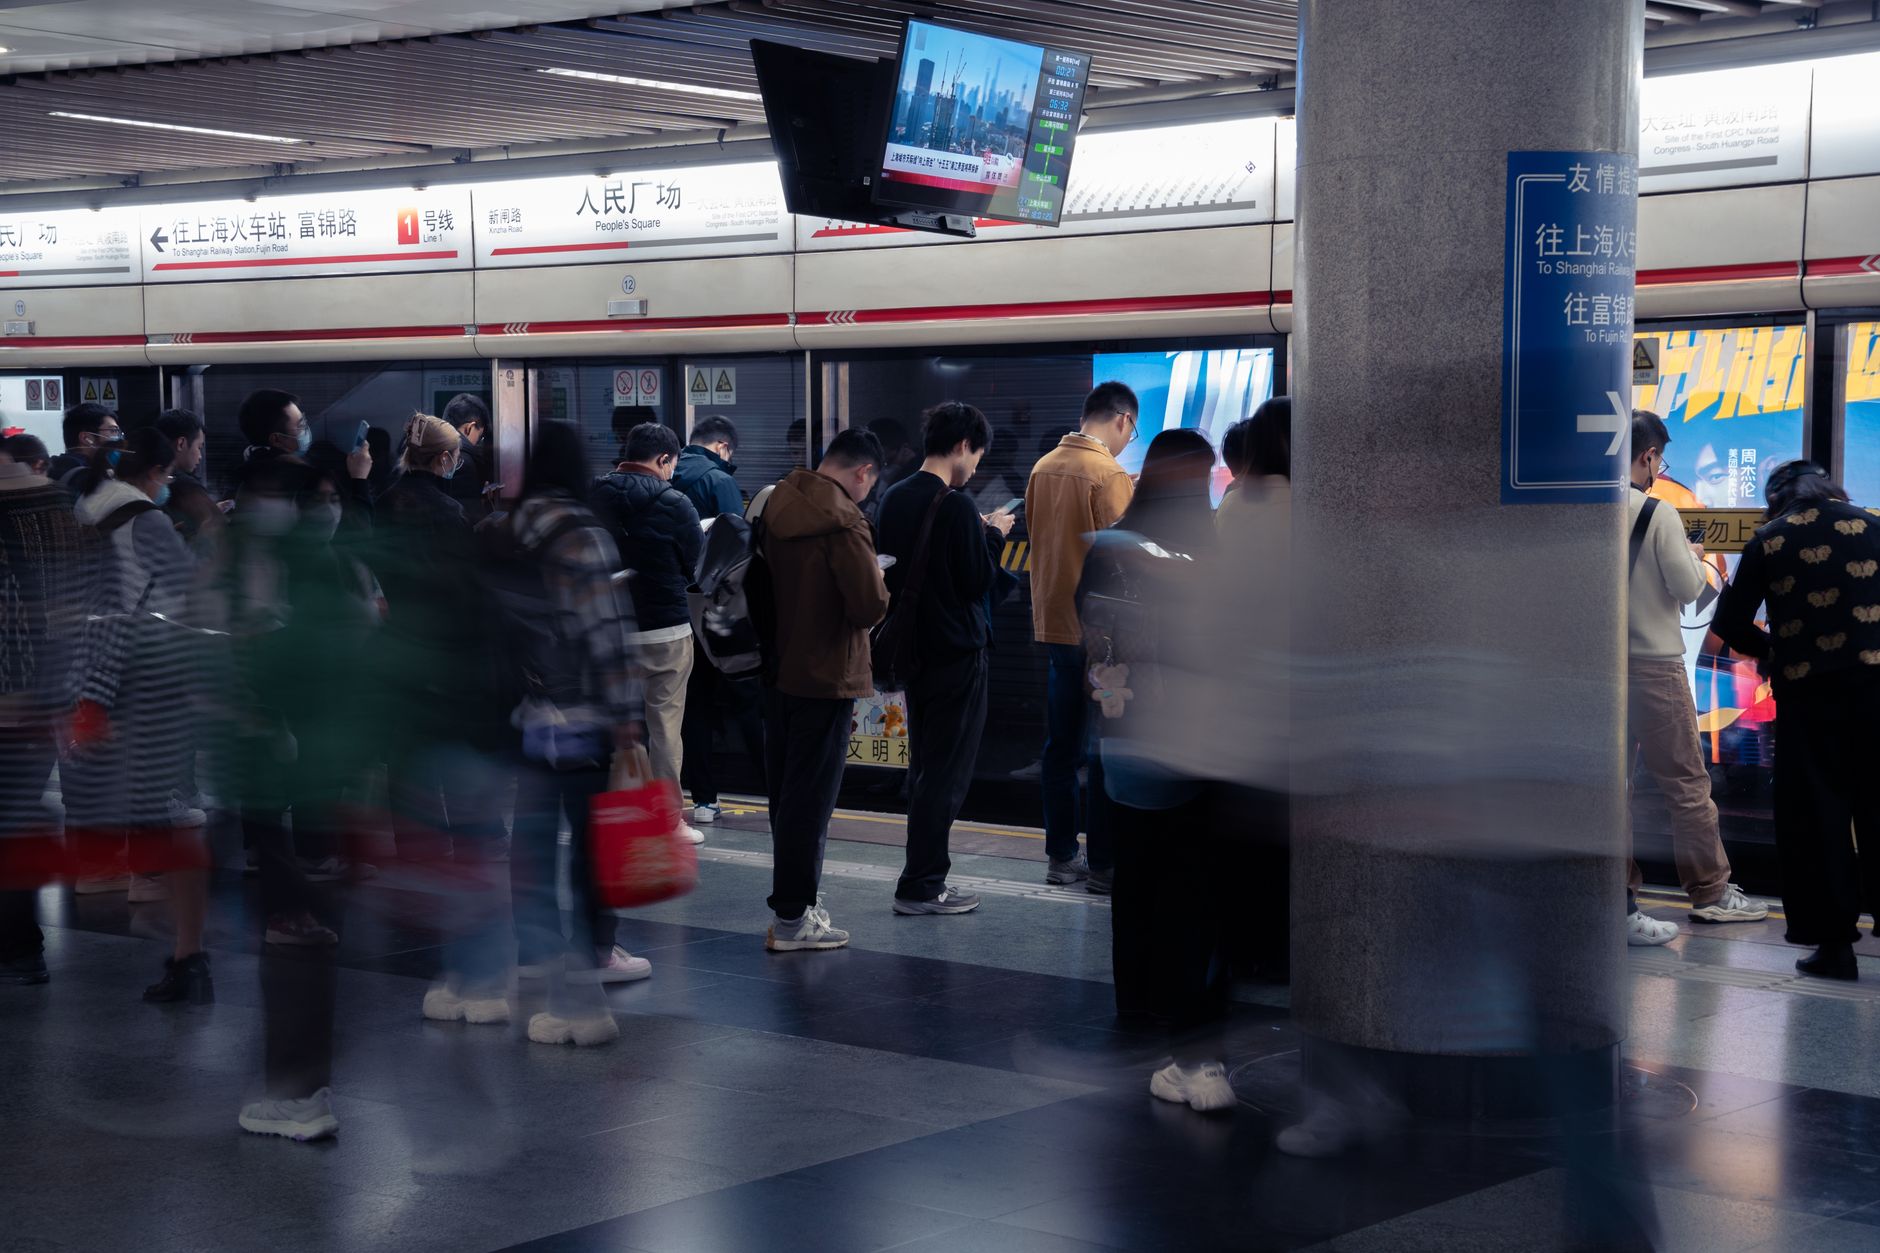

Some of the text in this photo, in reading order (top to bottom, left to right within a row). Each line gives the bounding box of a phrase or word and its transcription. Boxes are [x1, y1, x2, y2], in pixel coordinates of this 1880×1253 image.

[1757, 136, 1779, 145] Road
[576, 178, 682, 216] 人民广场
[404, 214, 412, 236] 1
[423, 209, 454, 232] 号线
[595, 217, 661, 232] People's Square
[423, 234, 437, 243] Line
[173, 248, 181, 256] To
[181, 247, 208, 257] Shanghai
[210, 246, 233, 256] Railway
[272, 243, 289, 252] Road
[1536, 261, 1552, 275] To
[1556, 261, 1607, 278] Shanghai
[1584, 329, 1597, 343] To
[1599, 329, 1618, 346] Fujin
[1740, 448, 1757, 498] 周杰伦
